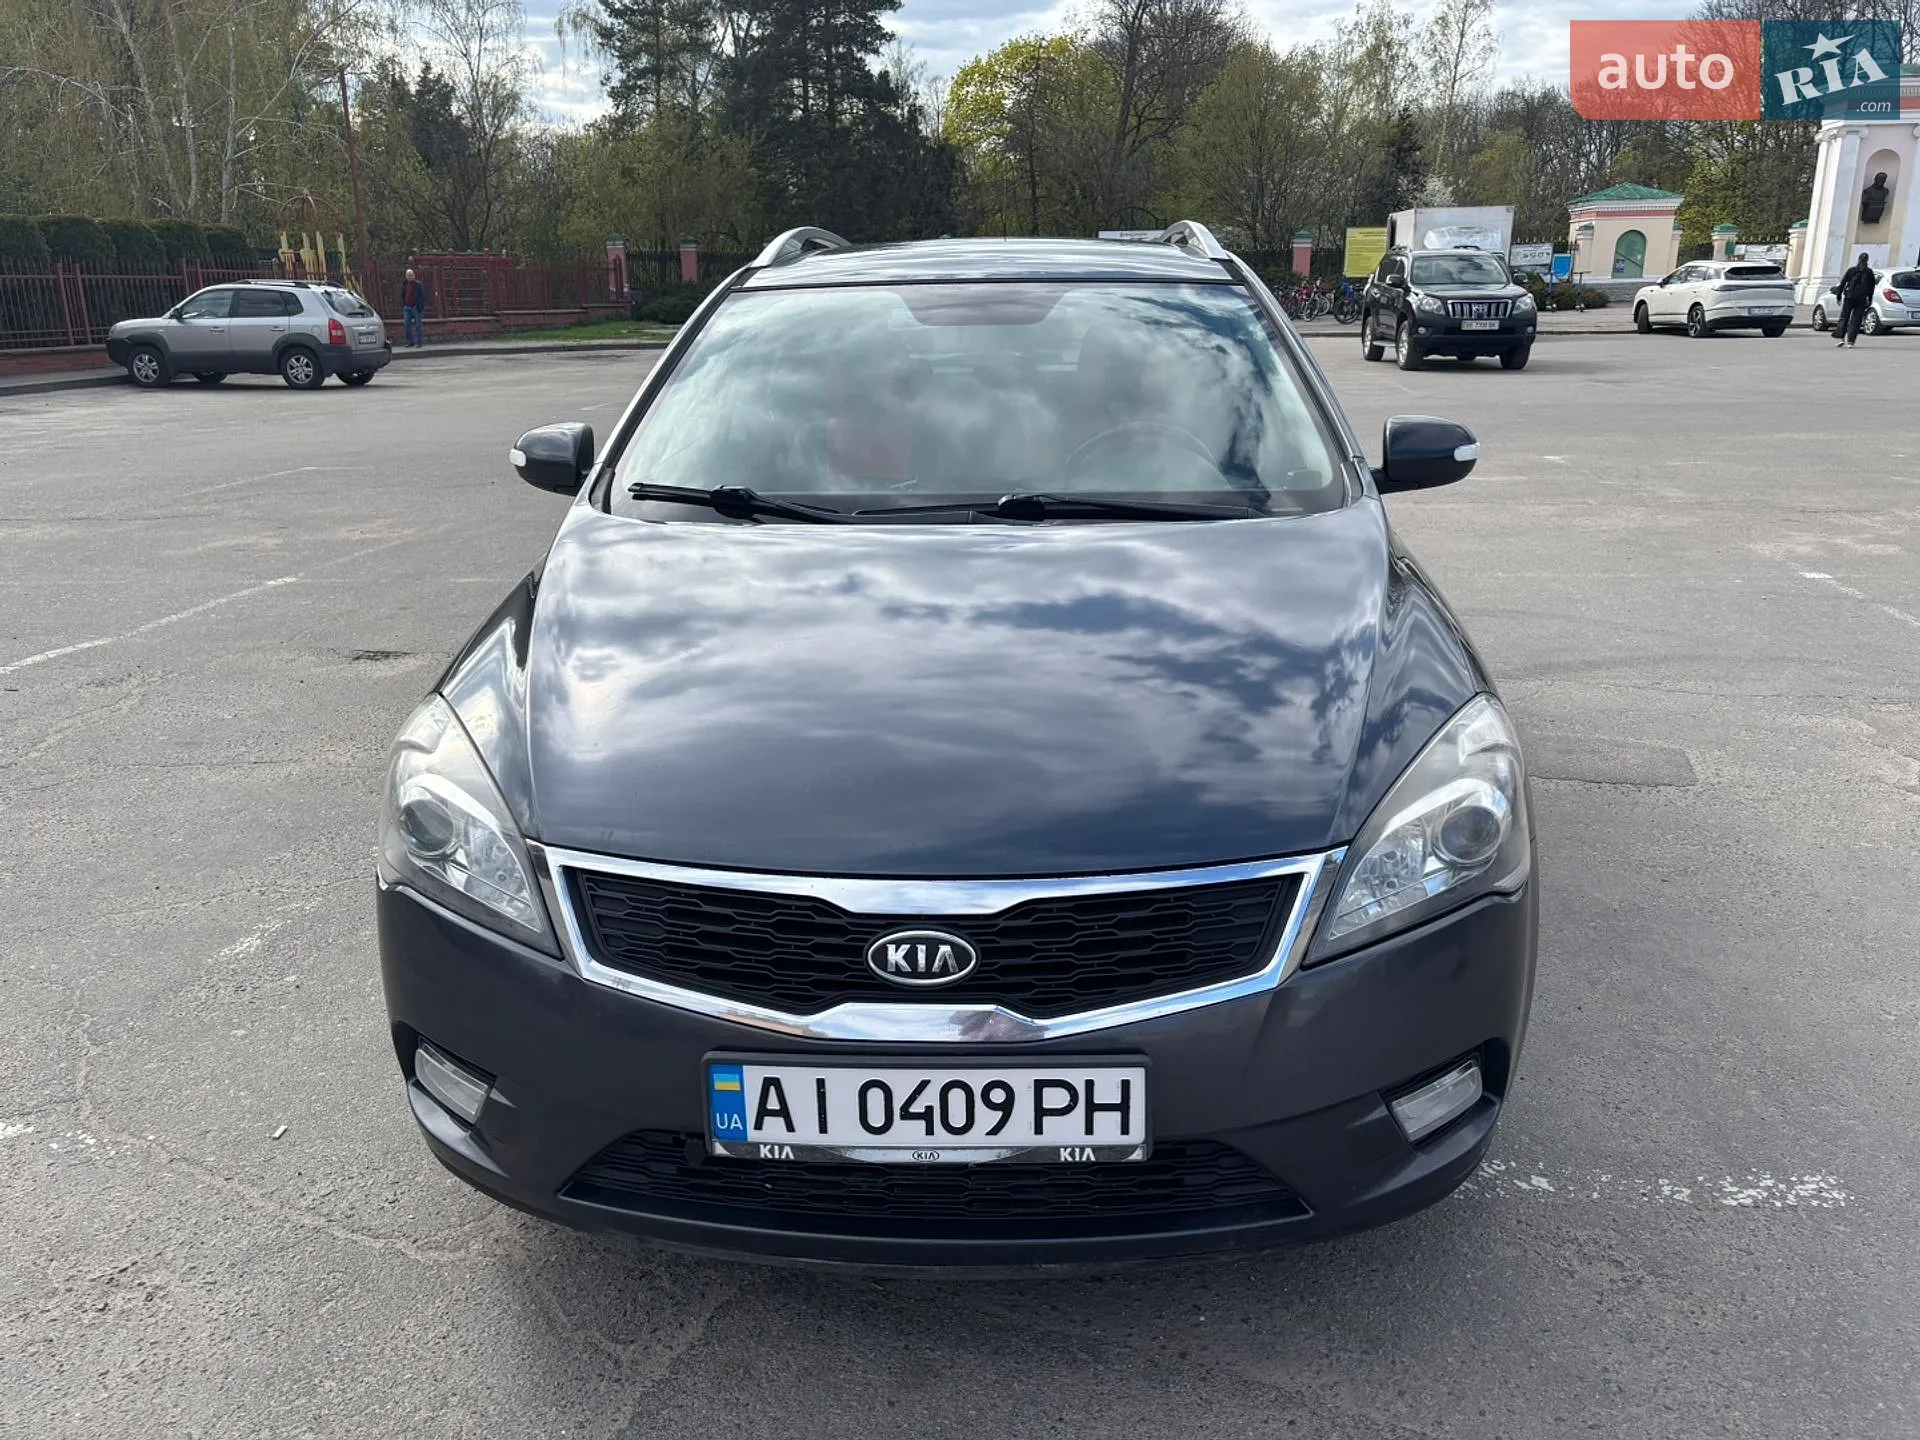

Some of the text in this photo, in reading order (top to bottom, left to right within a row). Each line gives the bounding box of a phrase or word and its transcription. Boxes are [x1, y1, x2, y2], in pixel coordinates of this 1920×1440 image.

[886, 944, 959, 972] KIA
[753, 1076, 1131, 1137] AI 0409 PH
[715, 1113, 743, 1131] UA
[759, 1144, 795, 1160] KIA
[917, 1151, 937, 1160] KIA
[1060, 1147, 1096, 1162] KIA
